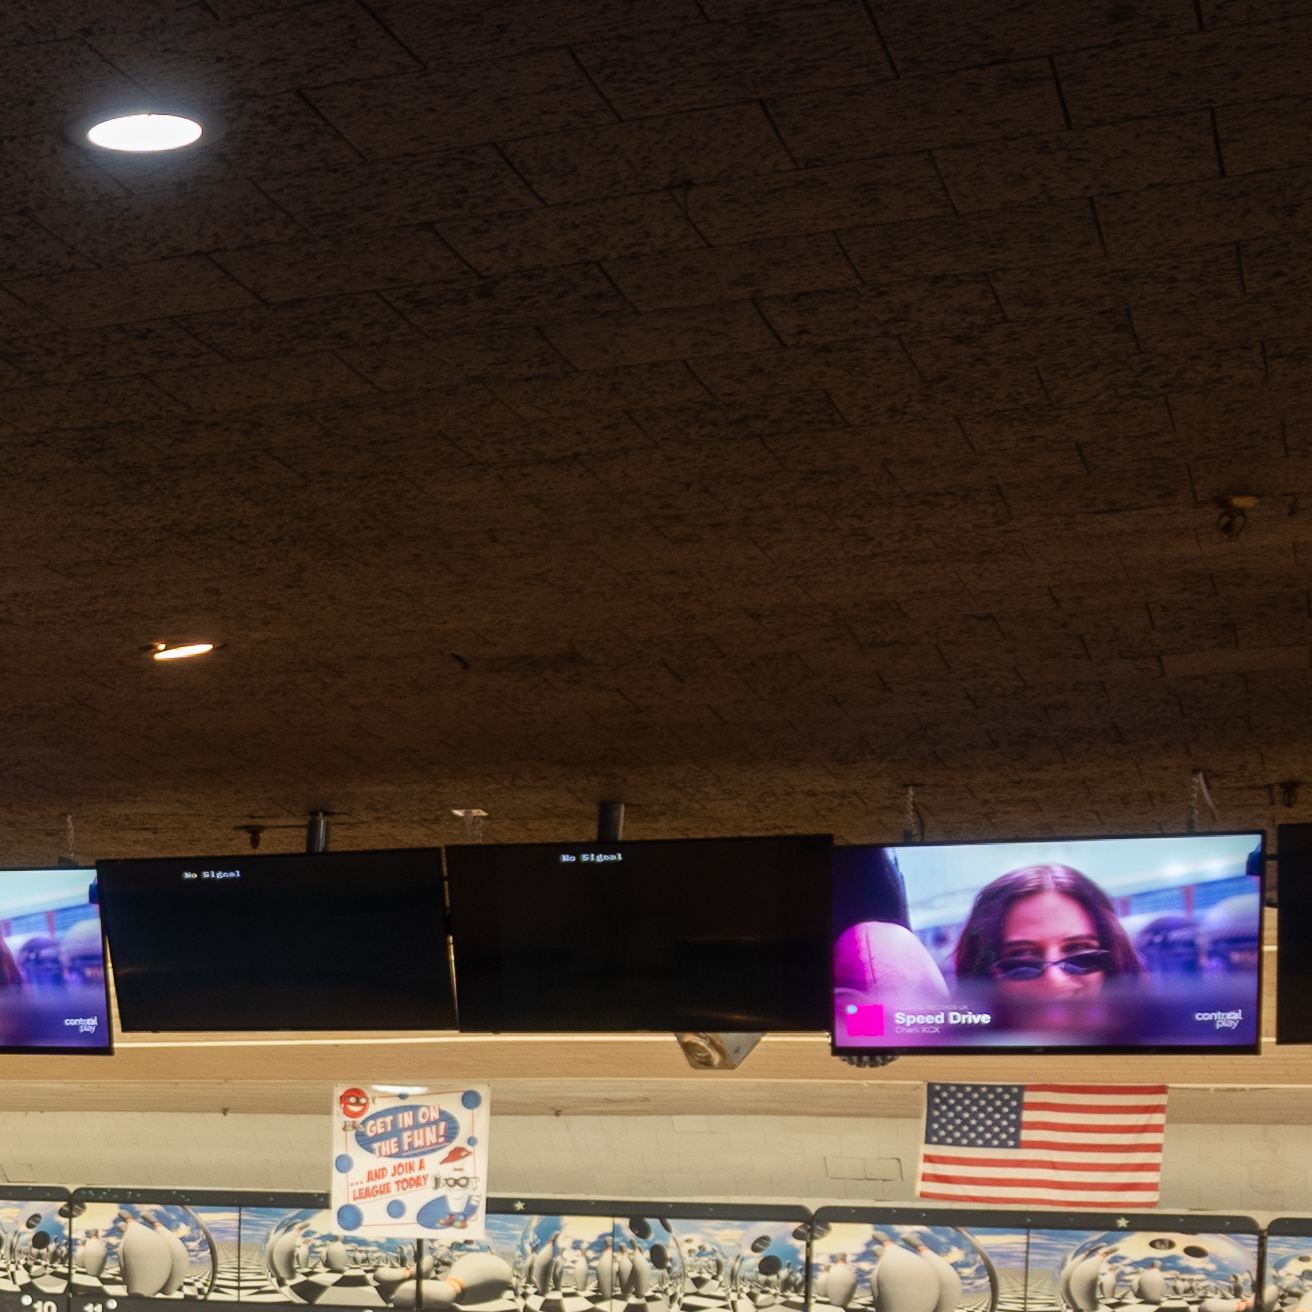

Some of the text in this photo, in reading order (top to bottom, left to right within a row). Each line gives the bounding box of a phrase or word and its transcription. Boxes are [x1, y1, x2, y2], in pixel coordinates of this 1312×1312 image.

[561, 852, 623, 863] No Signal
[366, 1104, 441, 1137] GET IN ON
[373, 1122, 448, 1158] THE FUN!
[353, 1174, 429, 1201] LEAGUE TODAY
